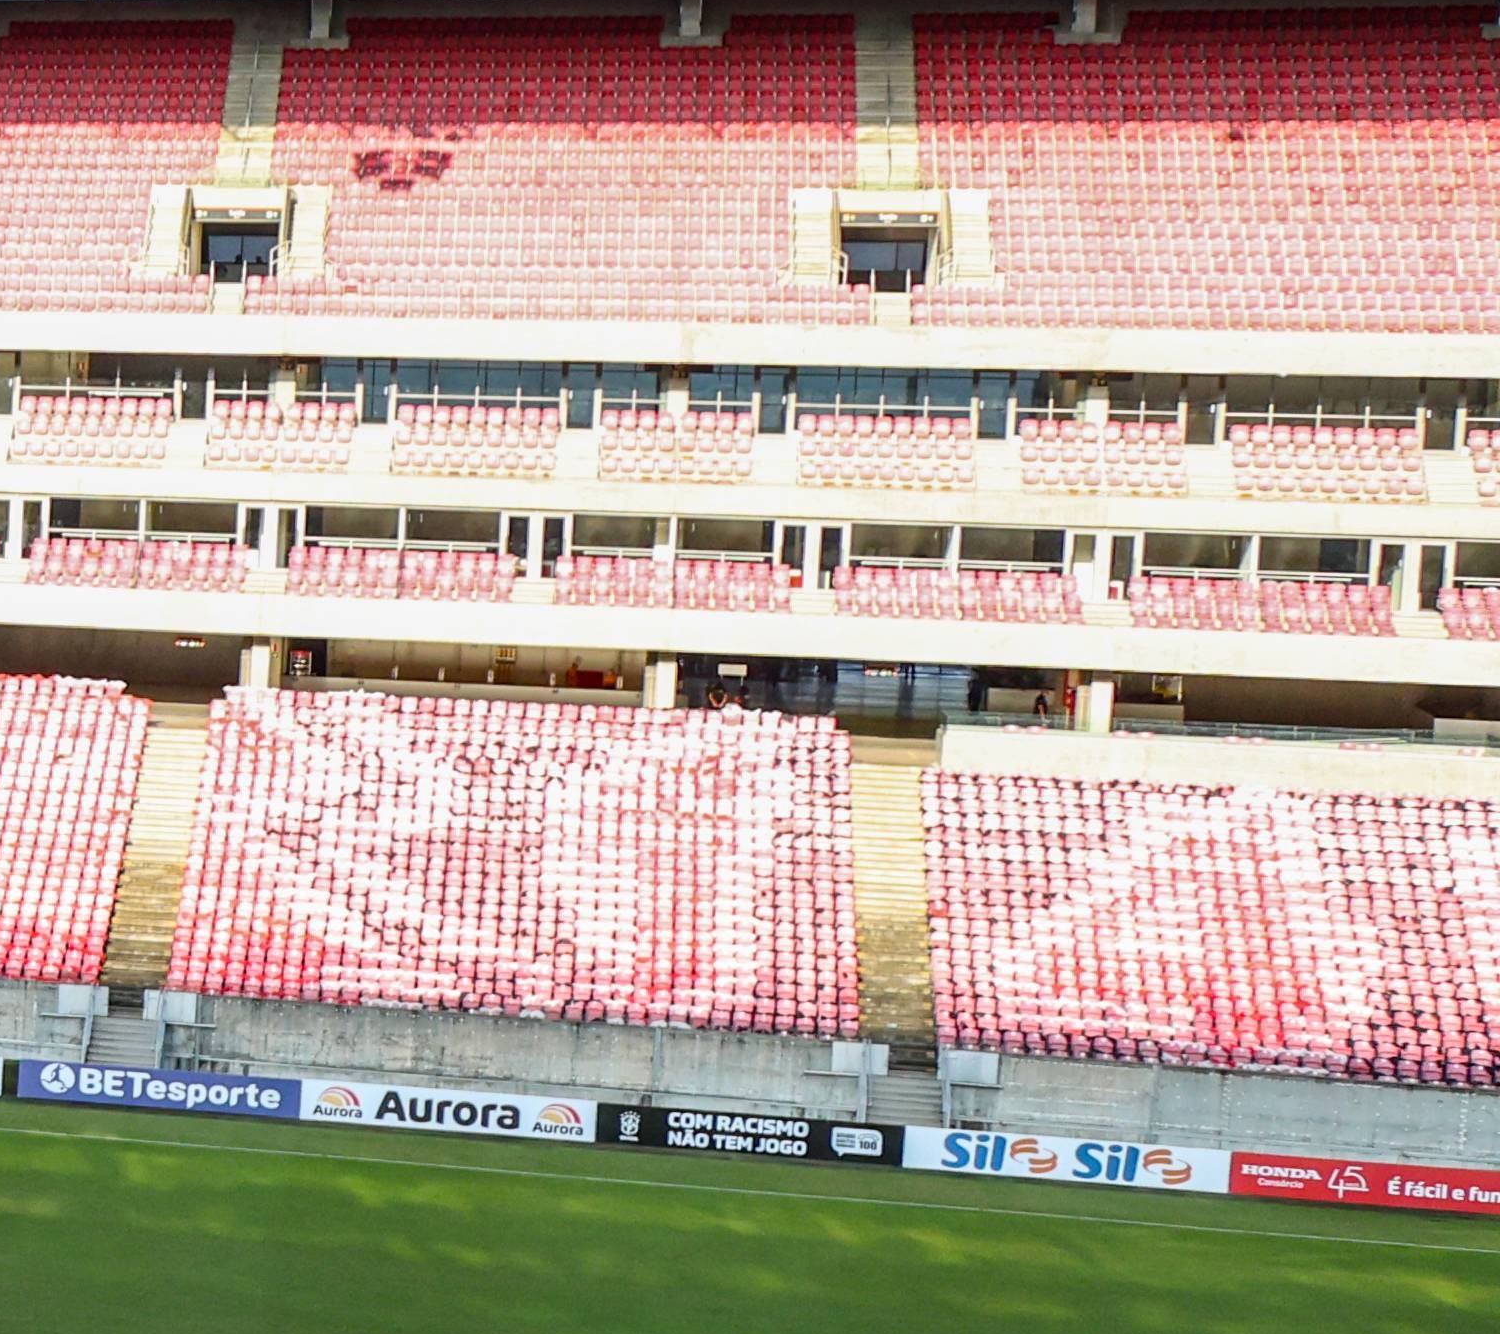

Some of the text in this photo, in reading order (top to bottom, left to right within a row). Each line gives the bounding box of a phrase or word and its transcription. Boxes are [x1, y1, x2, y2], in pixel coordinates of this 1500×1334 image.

[79, 1068, 280, 1109] BETesporte
[313, 1090, 584, 1136] Aurora Aurora Aurora
[667, 1112, 810, 1138] COM RACISMO
[667, 1129, 808, 1156] NÃO TEM JOGO
[940, 1132, 1138, 1182] Sil Sil
[1241, 1164, 1323, 1181] HONDA
[1387, 1176, 1402, 1195] É
[1404, 1179, 1447, 1200] fácil
[1451, 1187, 1465, 1201] e
